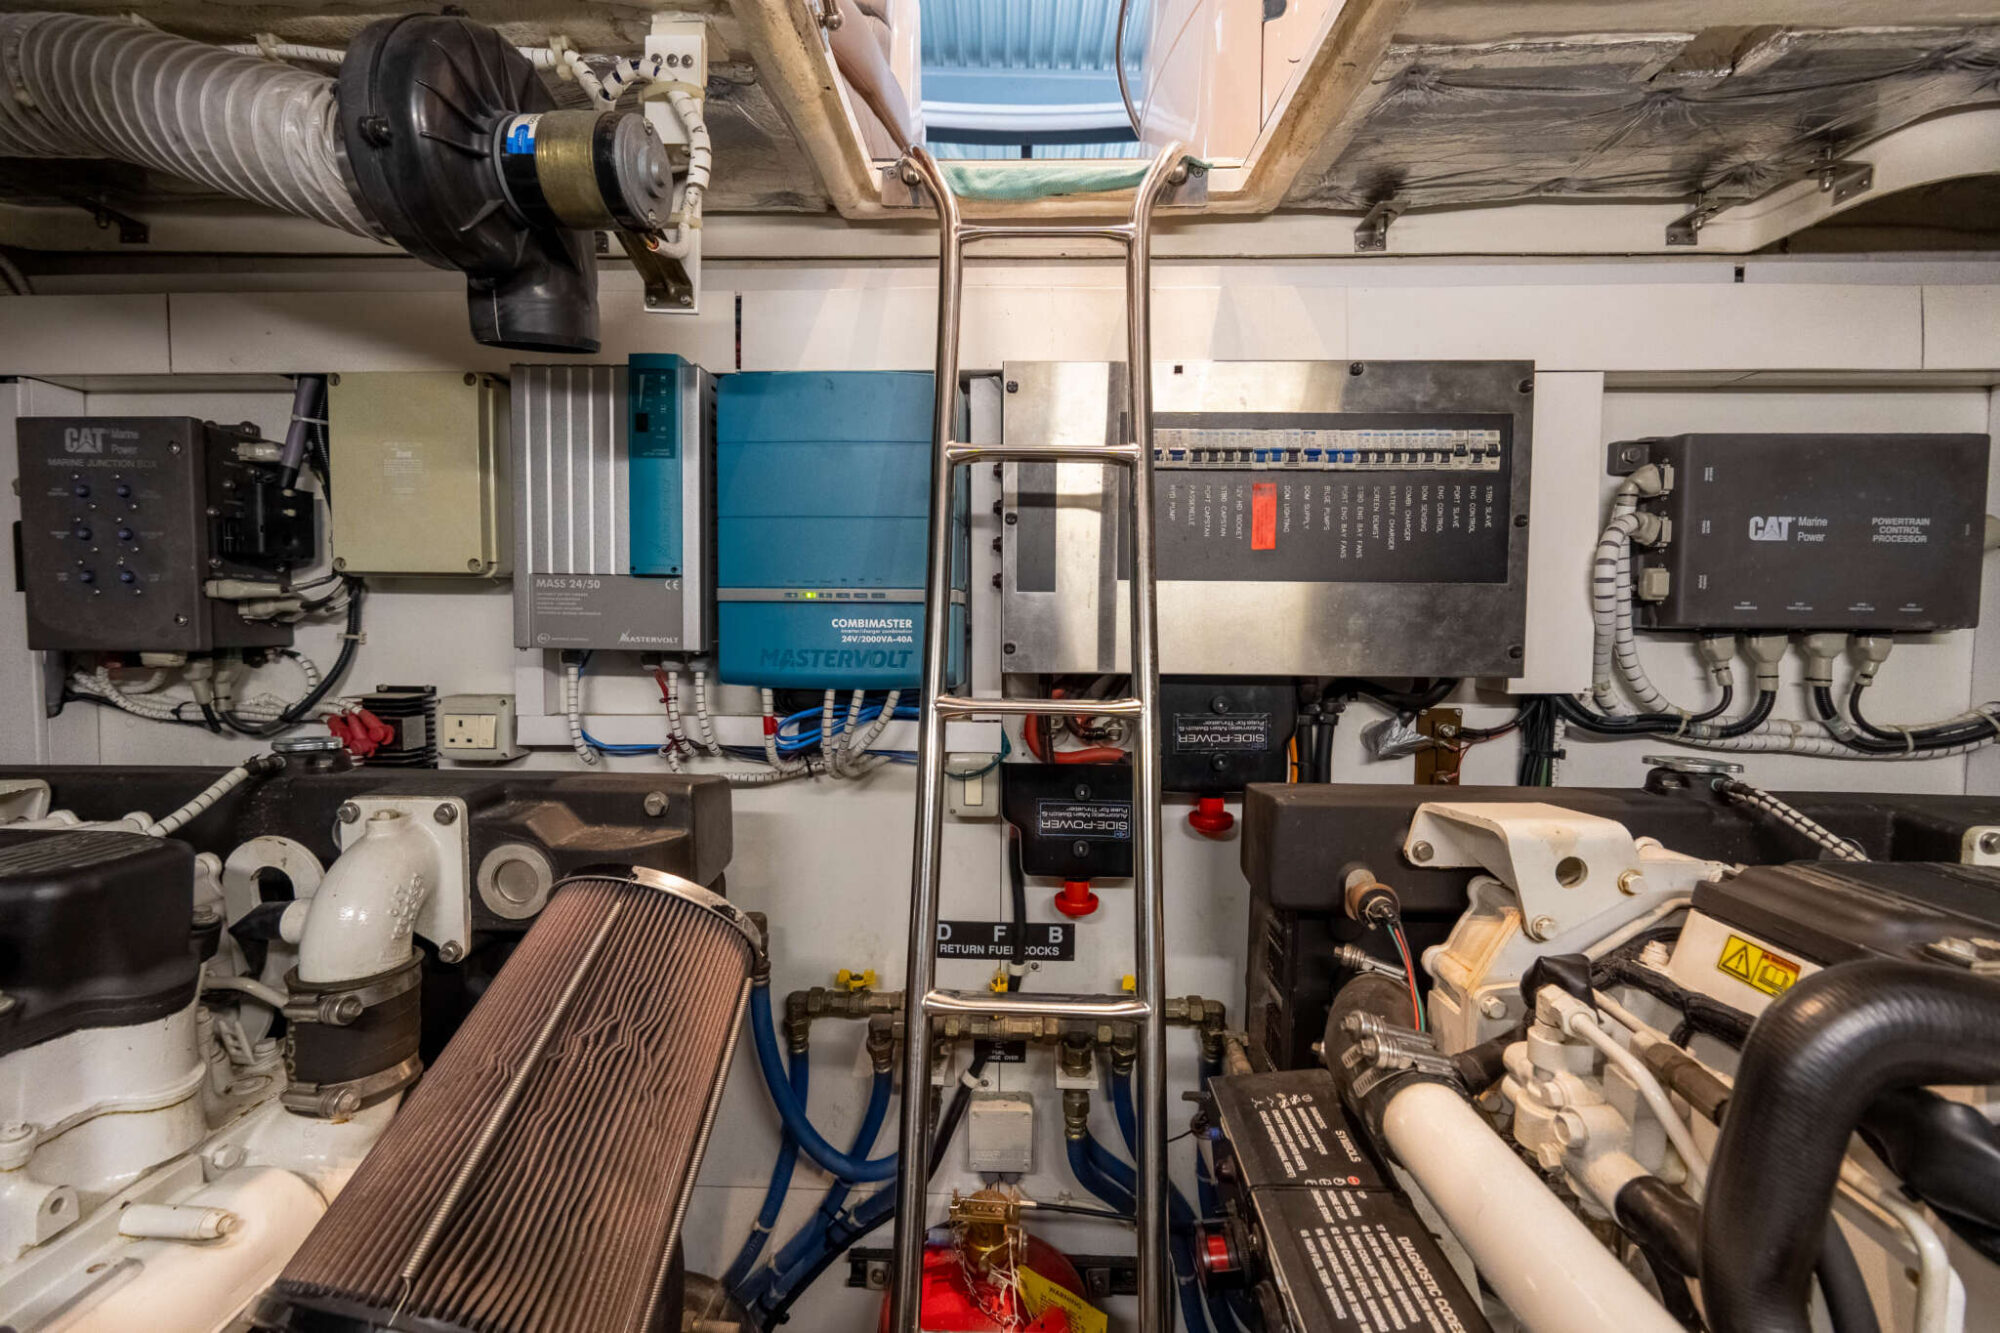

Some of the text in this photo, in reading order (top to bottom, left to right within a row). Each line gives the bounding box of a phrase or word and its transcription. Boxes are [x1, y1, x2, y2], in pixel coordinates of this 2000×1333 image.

[65, 428, 103, 453] CAT
[1798, 517, 1828, 527] Marine
[1872, 517, 1931, 526] POWERTRAIN
[1750, 516, 1792, 541] CAT
[1879, 526, 1922, 534] CONTROL
[1798, 532, 1826, 542] Power
[1872, 534, 1928, 543] PROCESSOR
[536, 580, 600, 589] MASS 24/50
[832, 619, 912, 628] COMBIMASTER
[619, 630, 679, 644] MASTERVOLT
[760, 649, 913, 669] MASTERVOLT
[1178, 733, 1265, 743] SIDE-POWER
[1041, 820, 1128, 830] SIDE-POWER
[937, 924, 1063, 944] D F B
[940, 944, 985, 954] RETURN
[1025, 946, 1060, 956] OCKS
[1335, 1129, 1362, 1162] SYMBOLS
[1397, 1236, 1442, 1297] DIAGNOSTIC
